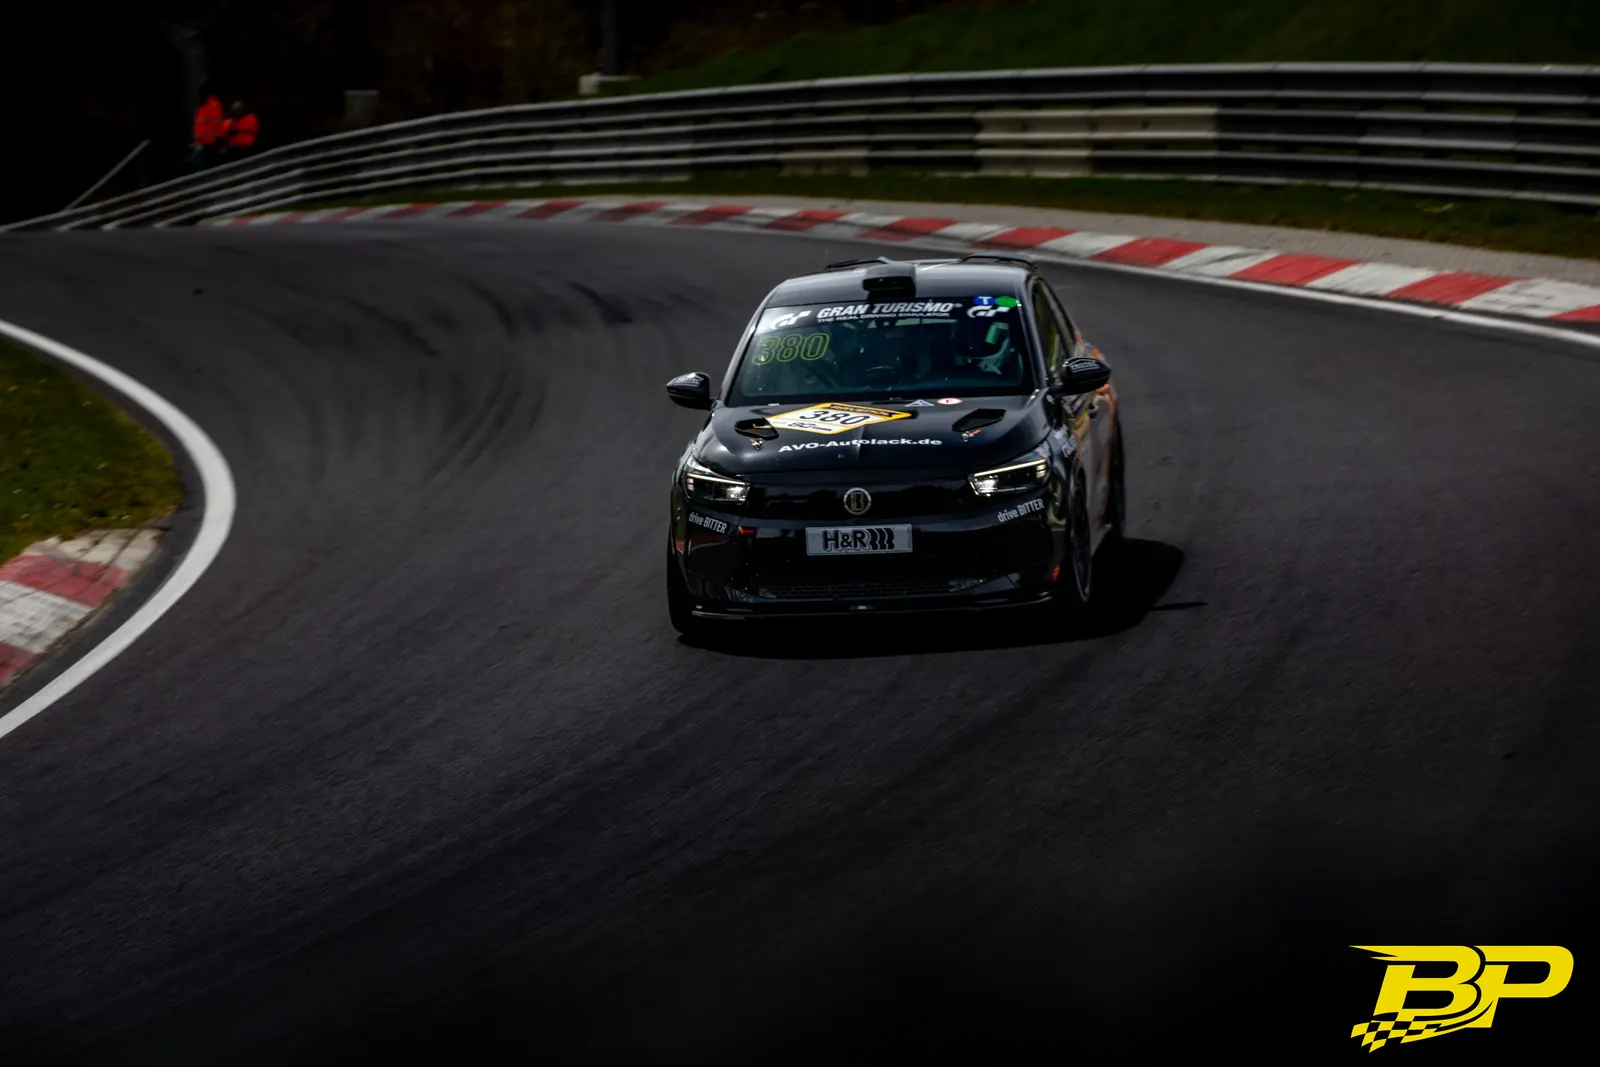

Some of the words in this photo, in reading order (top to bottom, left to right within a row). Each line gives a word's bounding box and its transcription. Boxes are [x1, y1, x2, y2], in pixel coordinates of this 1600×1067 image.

[816, 303, 870, 318] GRAN
[752, 332, 830, 365] 380
[800, 410, 870, 425] 380
[778, 438, 943, 452] AVO-Autolack.de
[997, 509, 1019, 523] drive
[1017, 498, 1045, 516] BITTER
[688, 511, 705, 527] drive
[703, 516, 728, 534] BITTER
[822, 528, 868, 551] H&R
